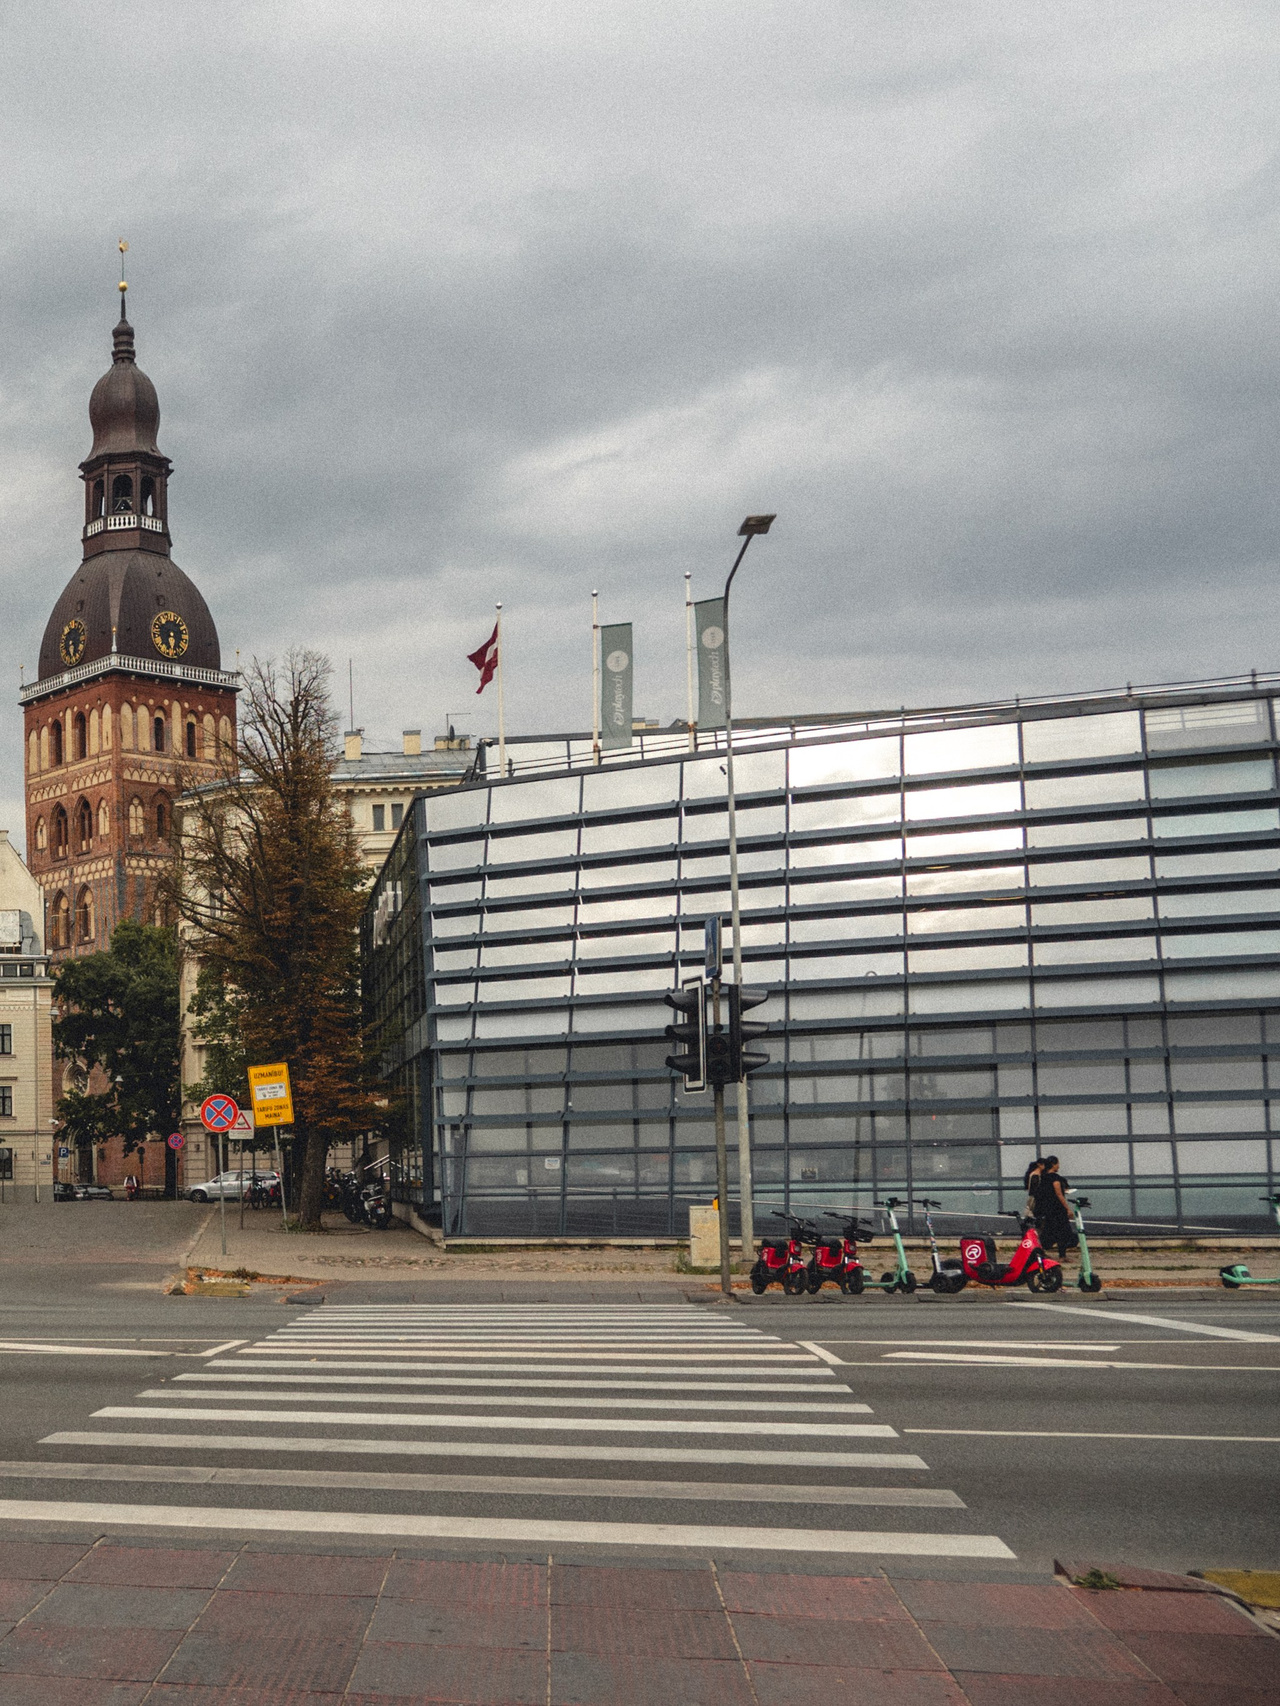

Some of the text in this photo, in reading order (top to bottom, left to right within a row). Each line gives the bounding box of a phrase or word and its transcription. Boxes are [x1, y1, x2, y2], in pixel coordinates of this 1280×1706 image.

[708, 651, 722, 690] playtech
[612, 675, 625, 713] playtech
[60, 1148, 67, 1156] P
